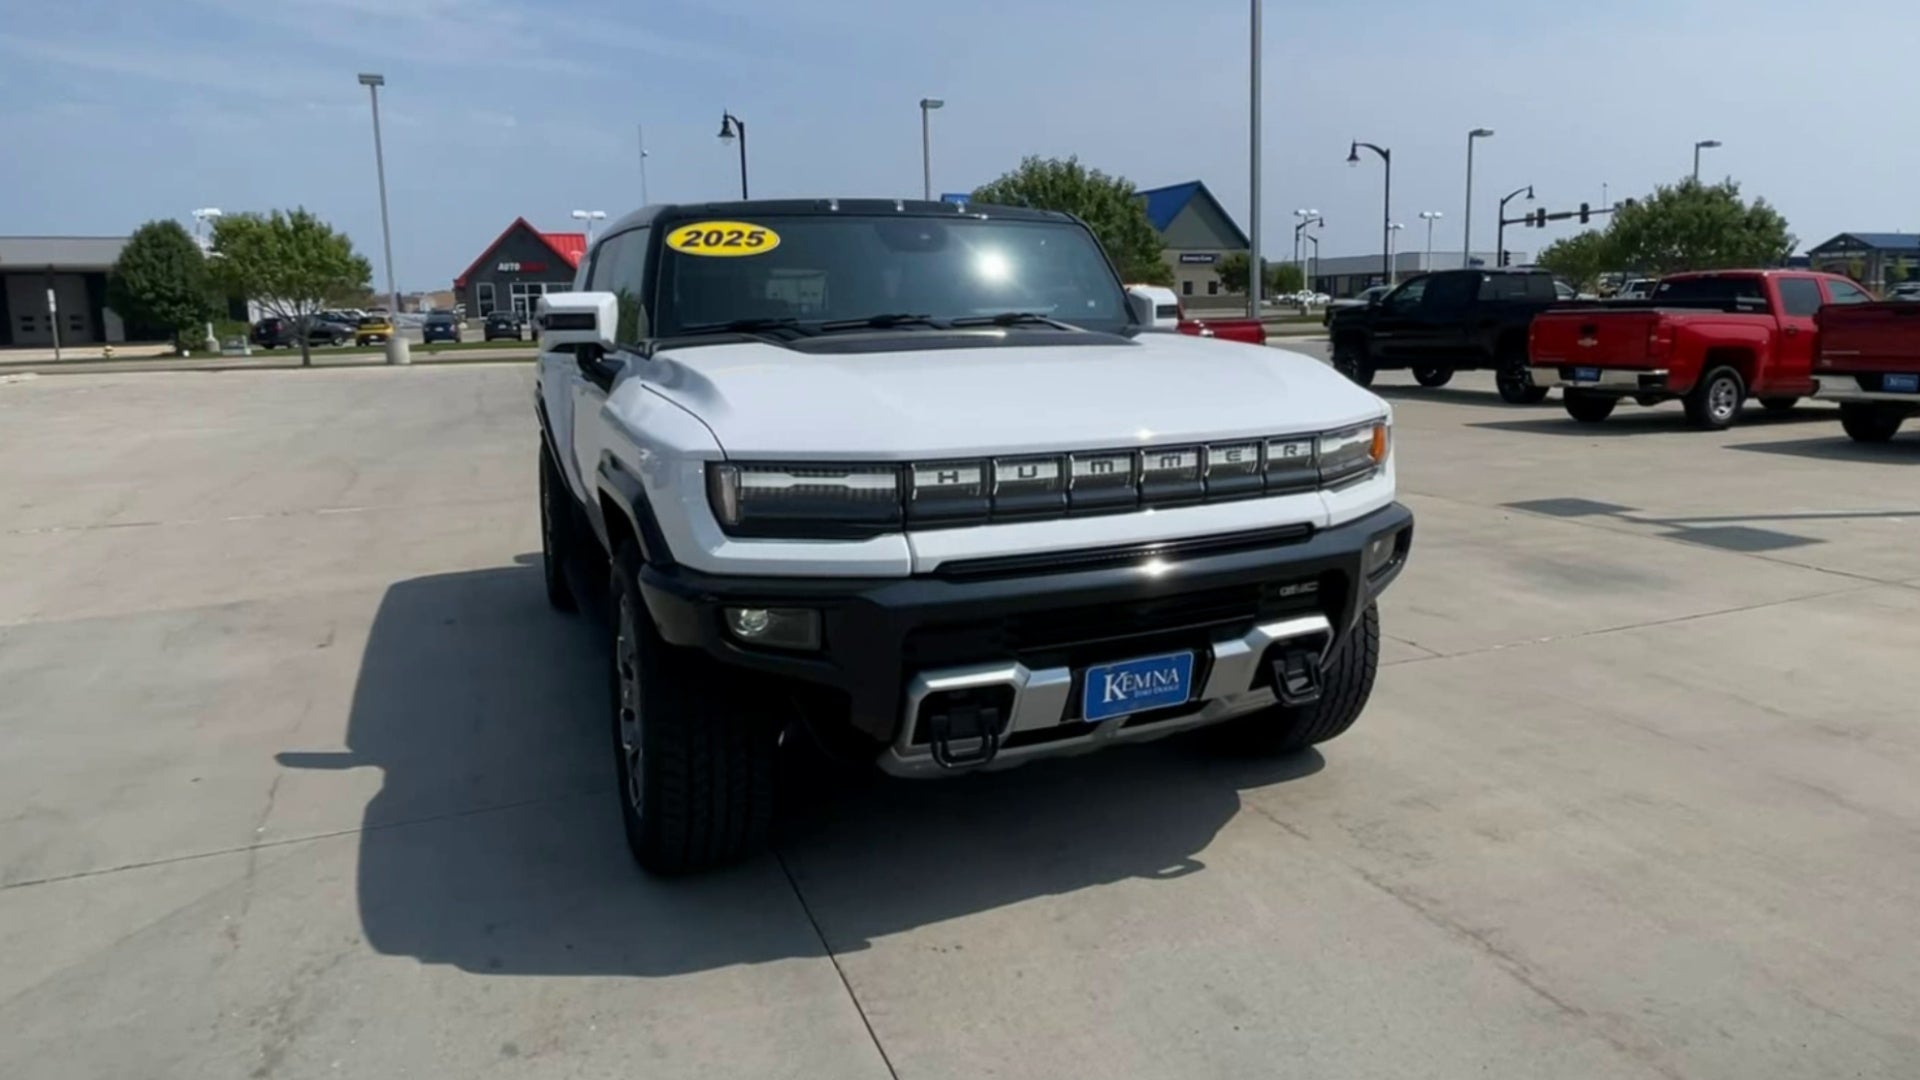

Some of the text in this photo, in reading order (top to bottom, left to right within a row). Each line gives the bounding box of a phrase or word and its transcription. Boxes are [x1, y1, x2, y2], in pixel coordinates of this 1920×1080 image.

[681, 229, 766, 248] 2025
[938, 444, 1298, 484] HUMMER
[1102, 667, 1179, 703] KEMNA
